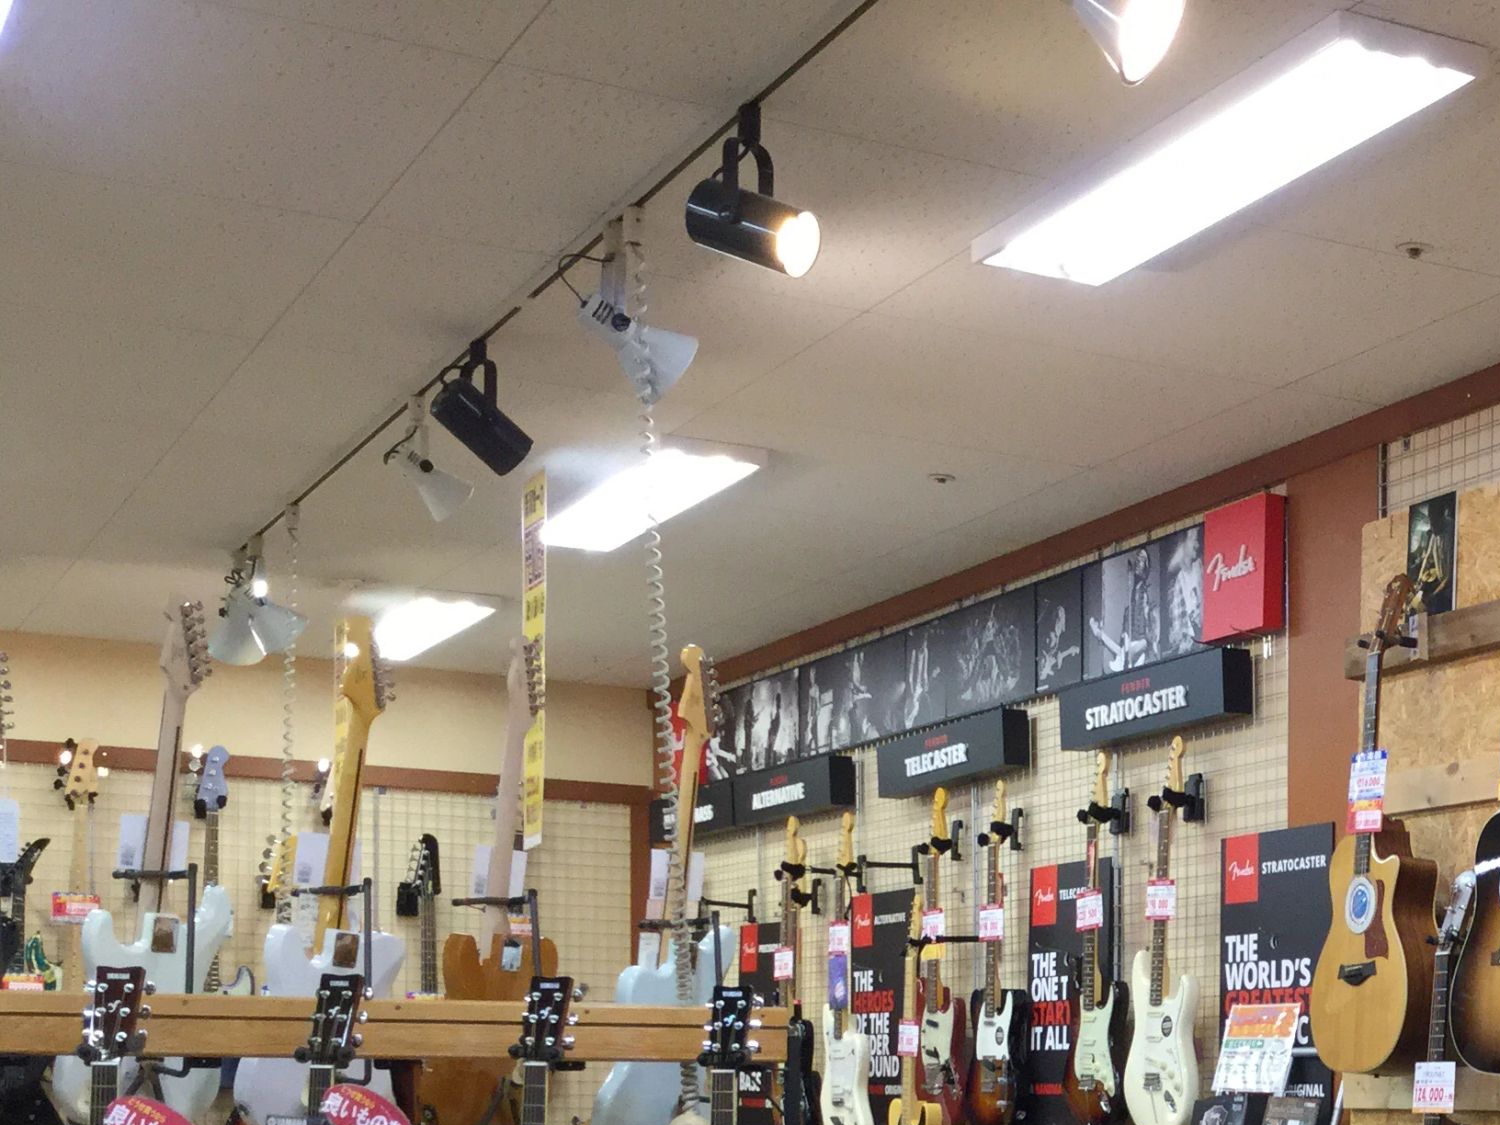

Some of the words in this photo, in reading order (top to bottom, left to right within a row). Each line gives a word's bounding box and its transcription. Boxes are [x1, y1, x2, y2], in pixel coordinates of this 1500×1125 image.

[1206, 543, 1257, 592] Fender
[1085, 684, 1188, 730] STRATOCASTER
[904, 742, 968, 778] TELECASTER
[1261, 854, 1327, 875] STRATOCASTER
[1225, 933, 1259, 962] THE
[1031, 951, 1057, 977] THE
[1225, 958, 1311, 991] WORLD'S
[853, 970, 874, 992] THE
[1031, 976, 1059, 1002] ONE
[853, 990, 895, 1013] HEROES
[869, 1013, 890, 1033] THE
[1031, 1028, 1043, 1051] IT
[1045, 1025, 1070, 1050] ALL
